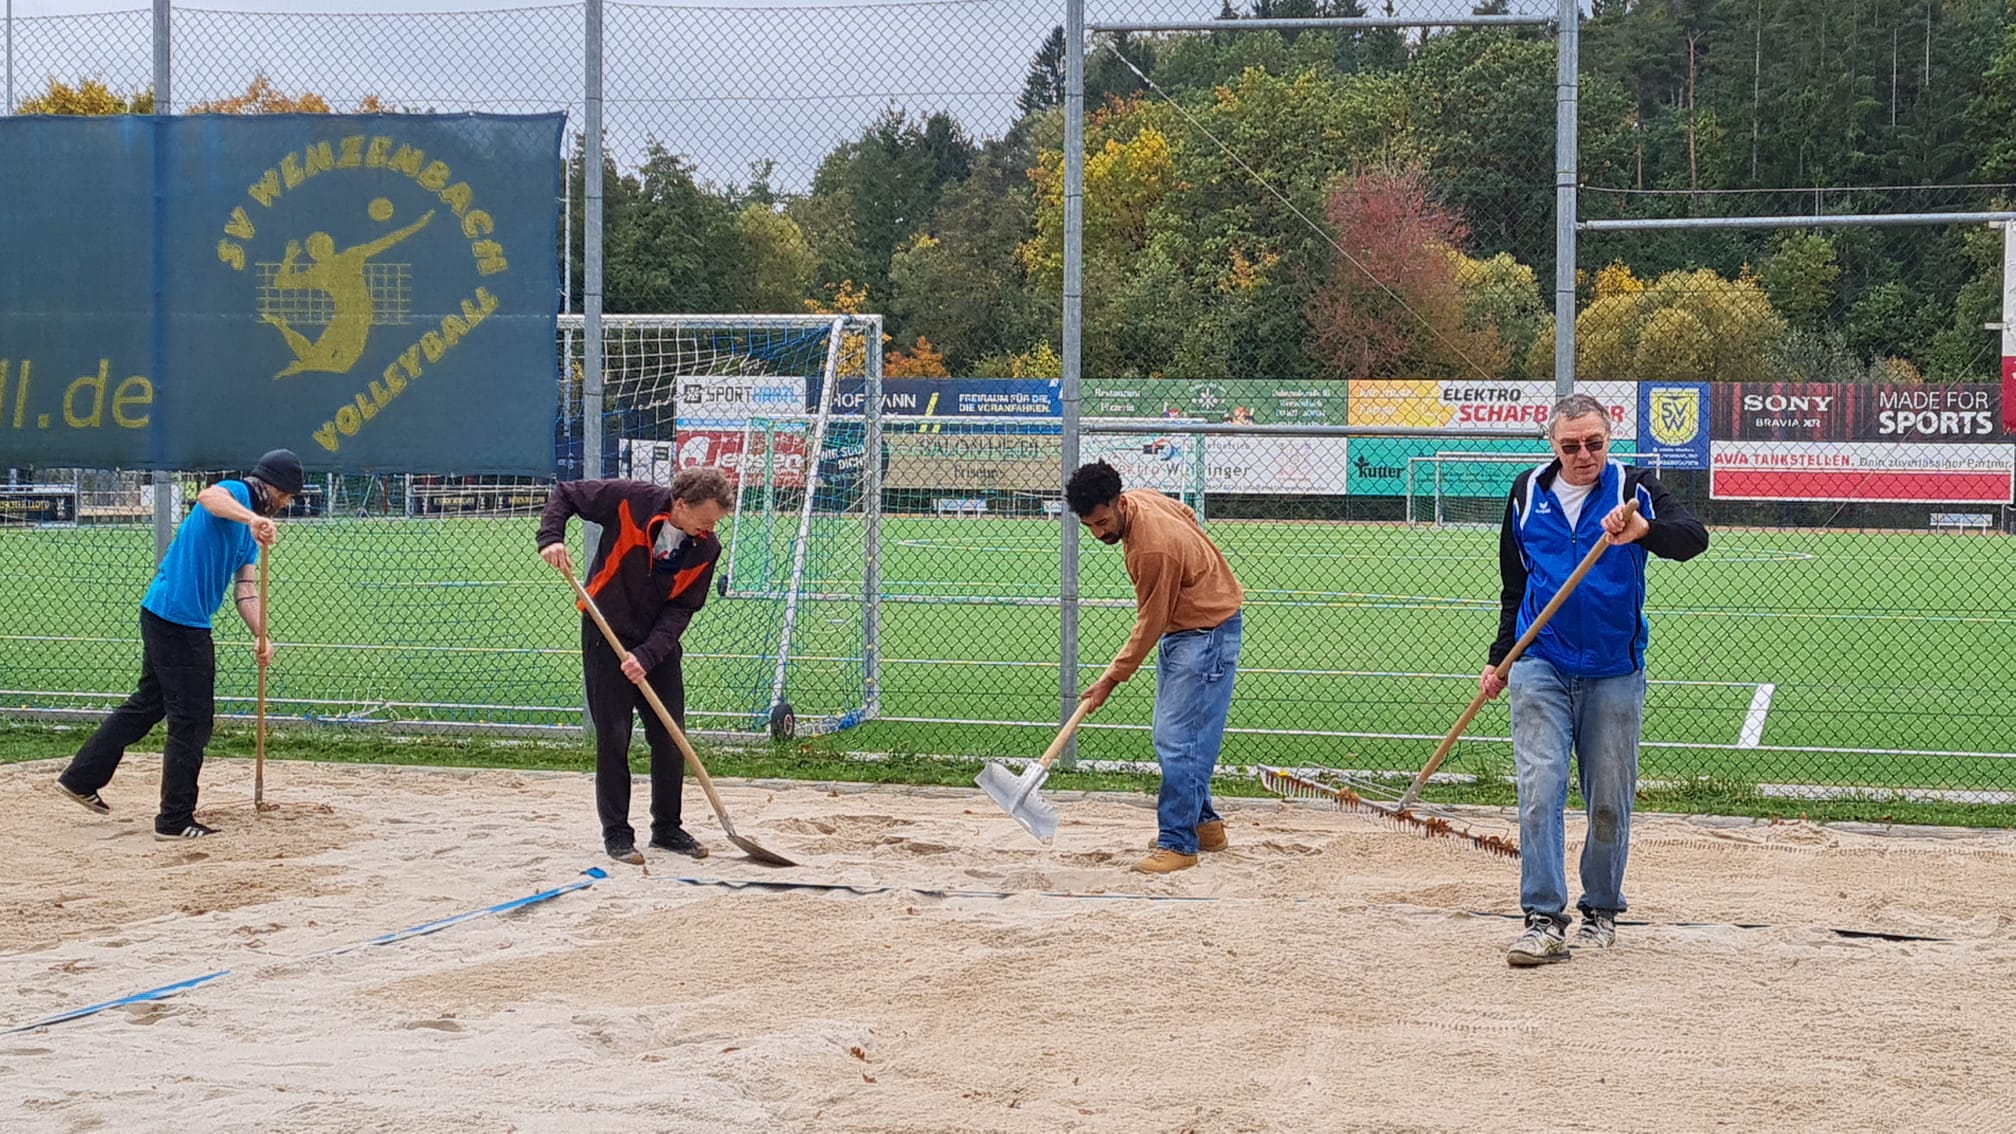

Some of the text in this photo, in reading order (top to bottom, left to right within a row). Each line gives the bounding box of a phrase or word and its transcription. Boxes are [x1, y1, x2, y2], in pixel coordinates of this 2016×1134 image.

[217, 135, 509, 275] SV WENZENBACH
[312, 286, 499, 452] VOLLEYBALL
[832, 392, 917, 408] HOFANN
[1443, 388, 1521, 402] ELEKTRO
[1744, 394, 1834, 411] SONY
[1879, 391, 1989, 409] MADE FOR
[959, 403, 976, 412] DIE
[1755, 418, 1821, 427] BRAVIA XR
[1879, 410, 1993, 434] SPORTS
[1714, 453, 1749, 465] AVIA
[1753, 454, 1855, 466] TANKSTELLEN.
[1860, 457, 1885, 467] Dein
